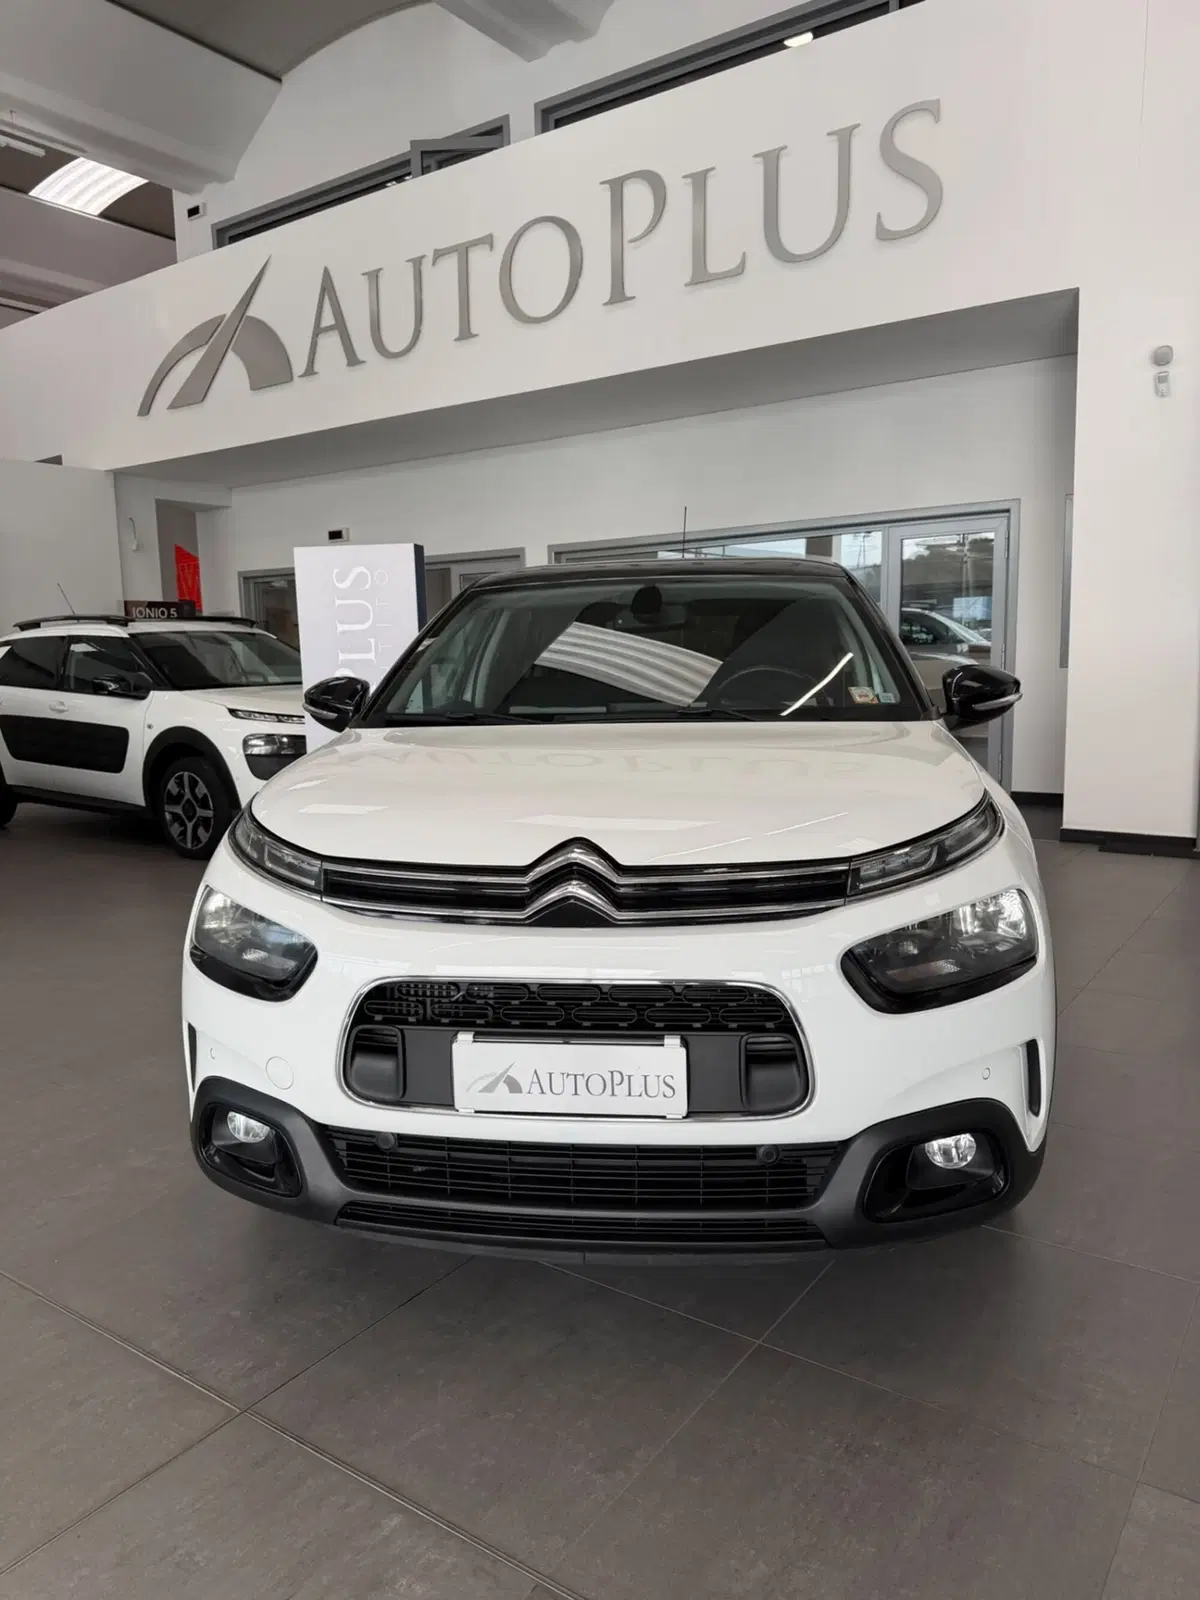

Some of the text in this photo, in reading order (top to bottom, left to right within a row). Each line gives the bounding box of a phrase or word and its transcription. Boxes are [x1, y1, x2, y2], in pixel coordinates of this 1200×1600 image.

[298, 98, 944, 378] AUTOPLUS
[170, 607, 178, 618] 5
[527, 1068, 676, 1099] AUTOPLUS
